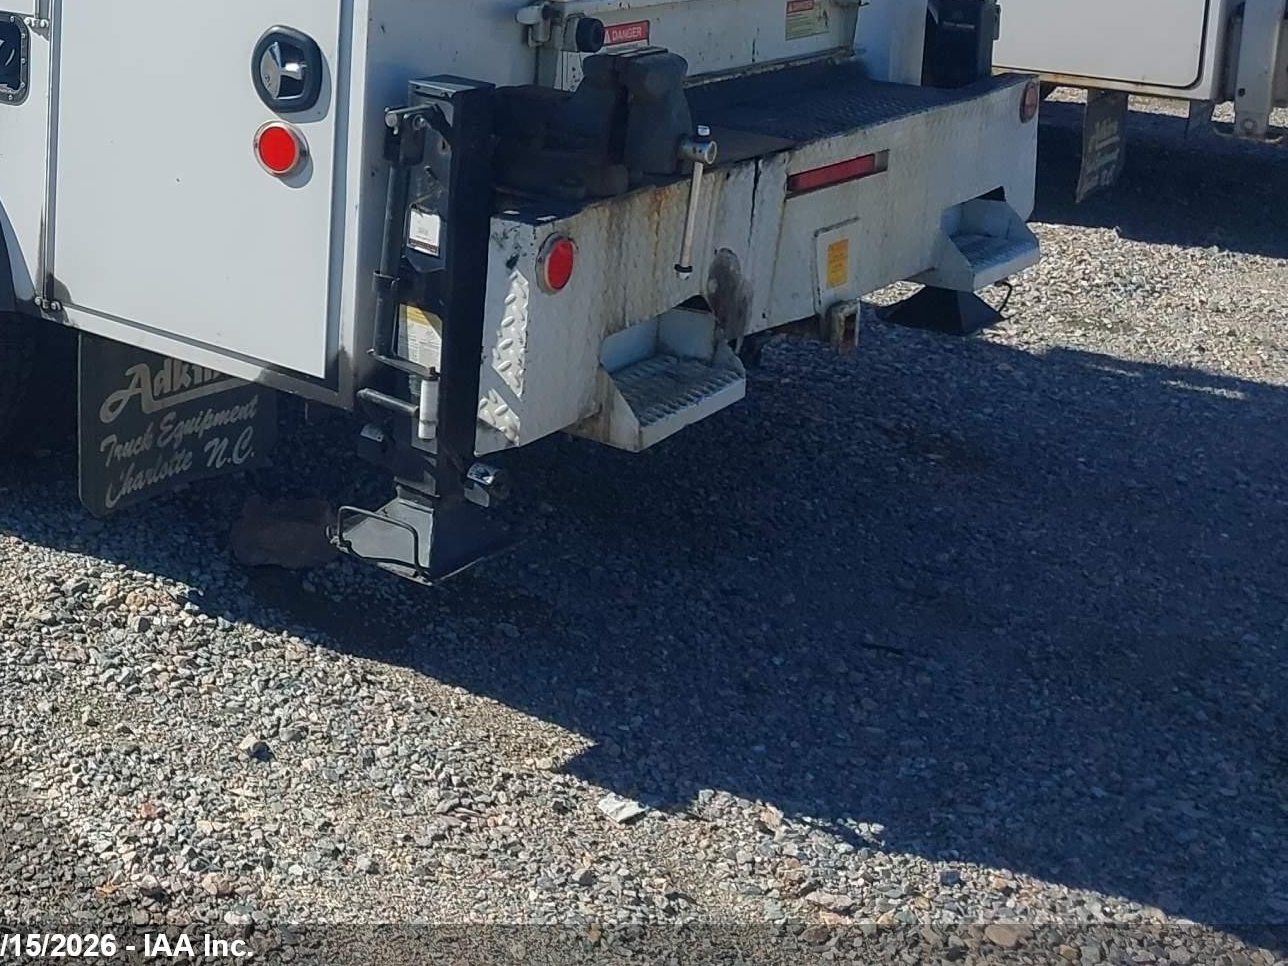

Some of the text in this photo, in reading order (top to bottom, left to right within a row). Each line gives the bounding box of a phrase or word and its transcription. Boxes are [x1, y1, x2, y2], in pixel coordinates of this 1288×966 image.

[612, 26, 642, 42] DANGER
[100, 394, 259, 467] Truck Equipment
[105, 425, 255, 509] Charlotte N.C.
